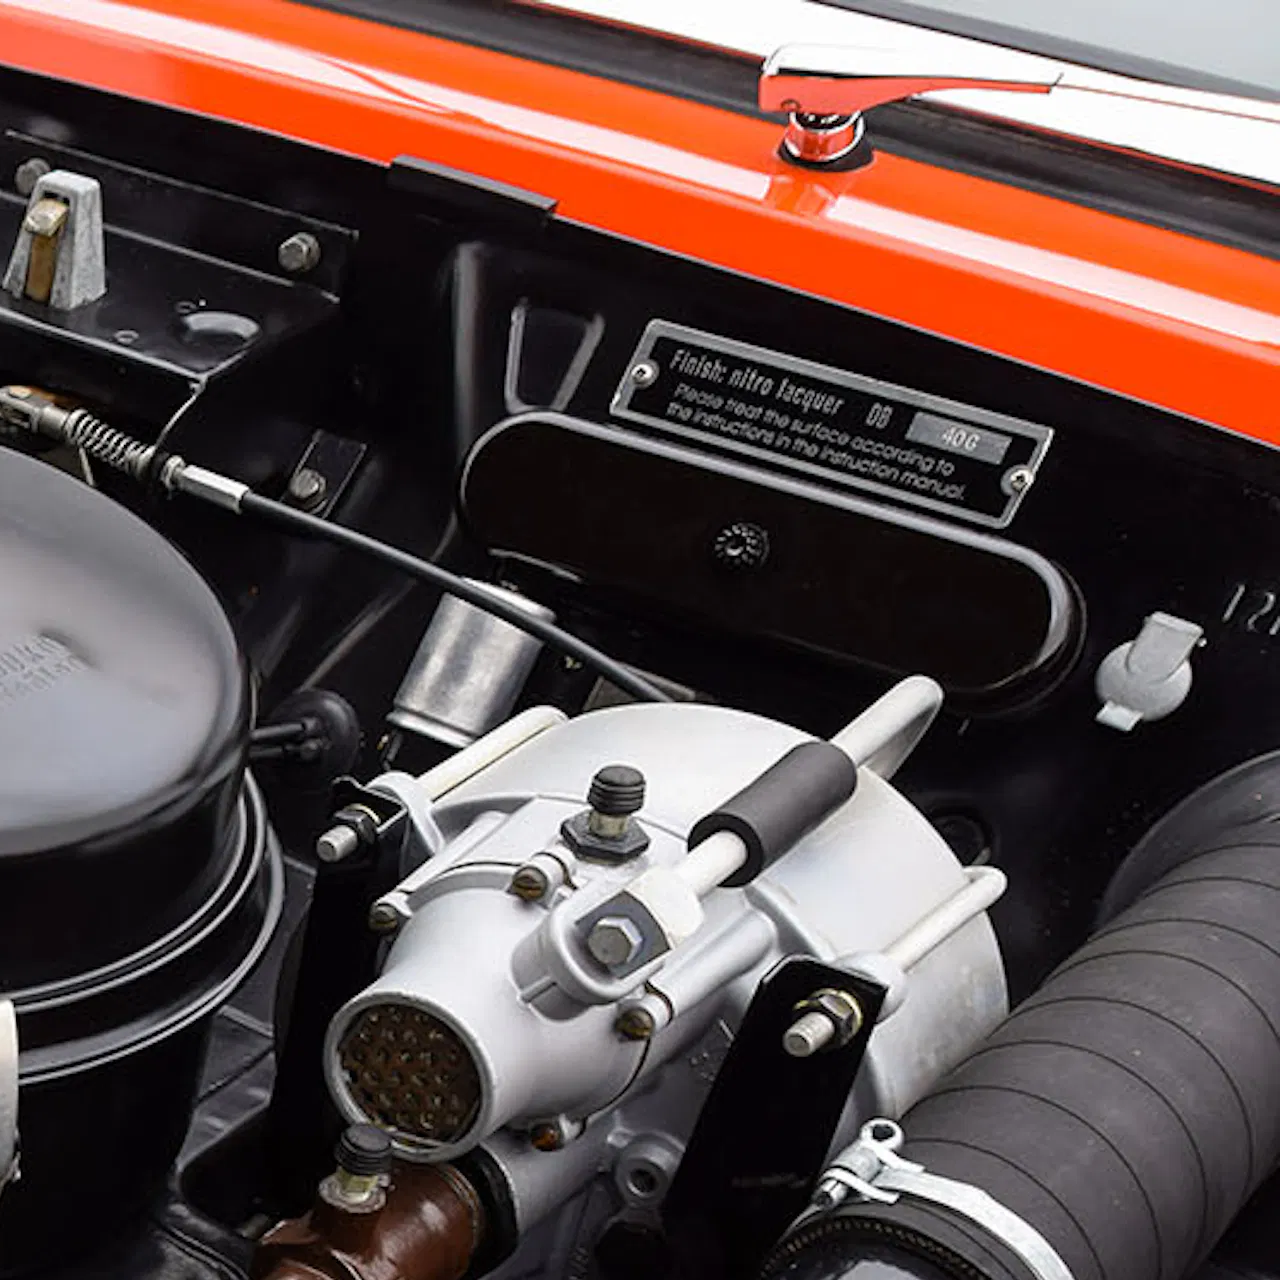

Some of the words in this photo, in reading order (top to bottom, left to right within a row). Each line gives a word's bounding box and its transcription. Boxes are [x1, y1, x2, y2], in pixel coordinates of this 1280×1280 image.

[669, 350, 728, 383] Finish:
[728, 367, 775, 396] nitro
[775, 377, 845, 415] lacquer
[665, 401, 693, 422] the
[693, 408, 775, 446] instructions
[791, 436, 819, 458] the
[819, 444, 900, 481] instruction
[674, 382, 725, 409] Please
[724, 398, 764, 420] treat
[763, 408, 791, 429] the
[791, 418, 851, 446] surface
[850, 436, 936, 474] according
[936, 458, 955, 477] to
